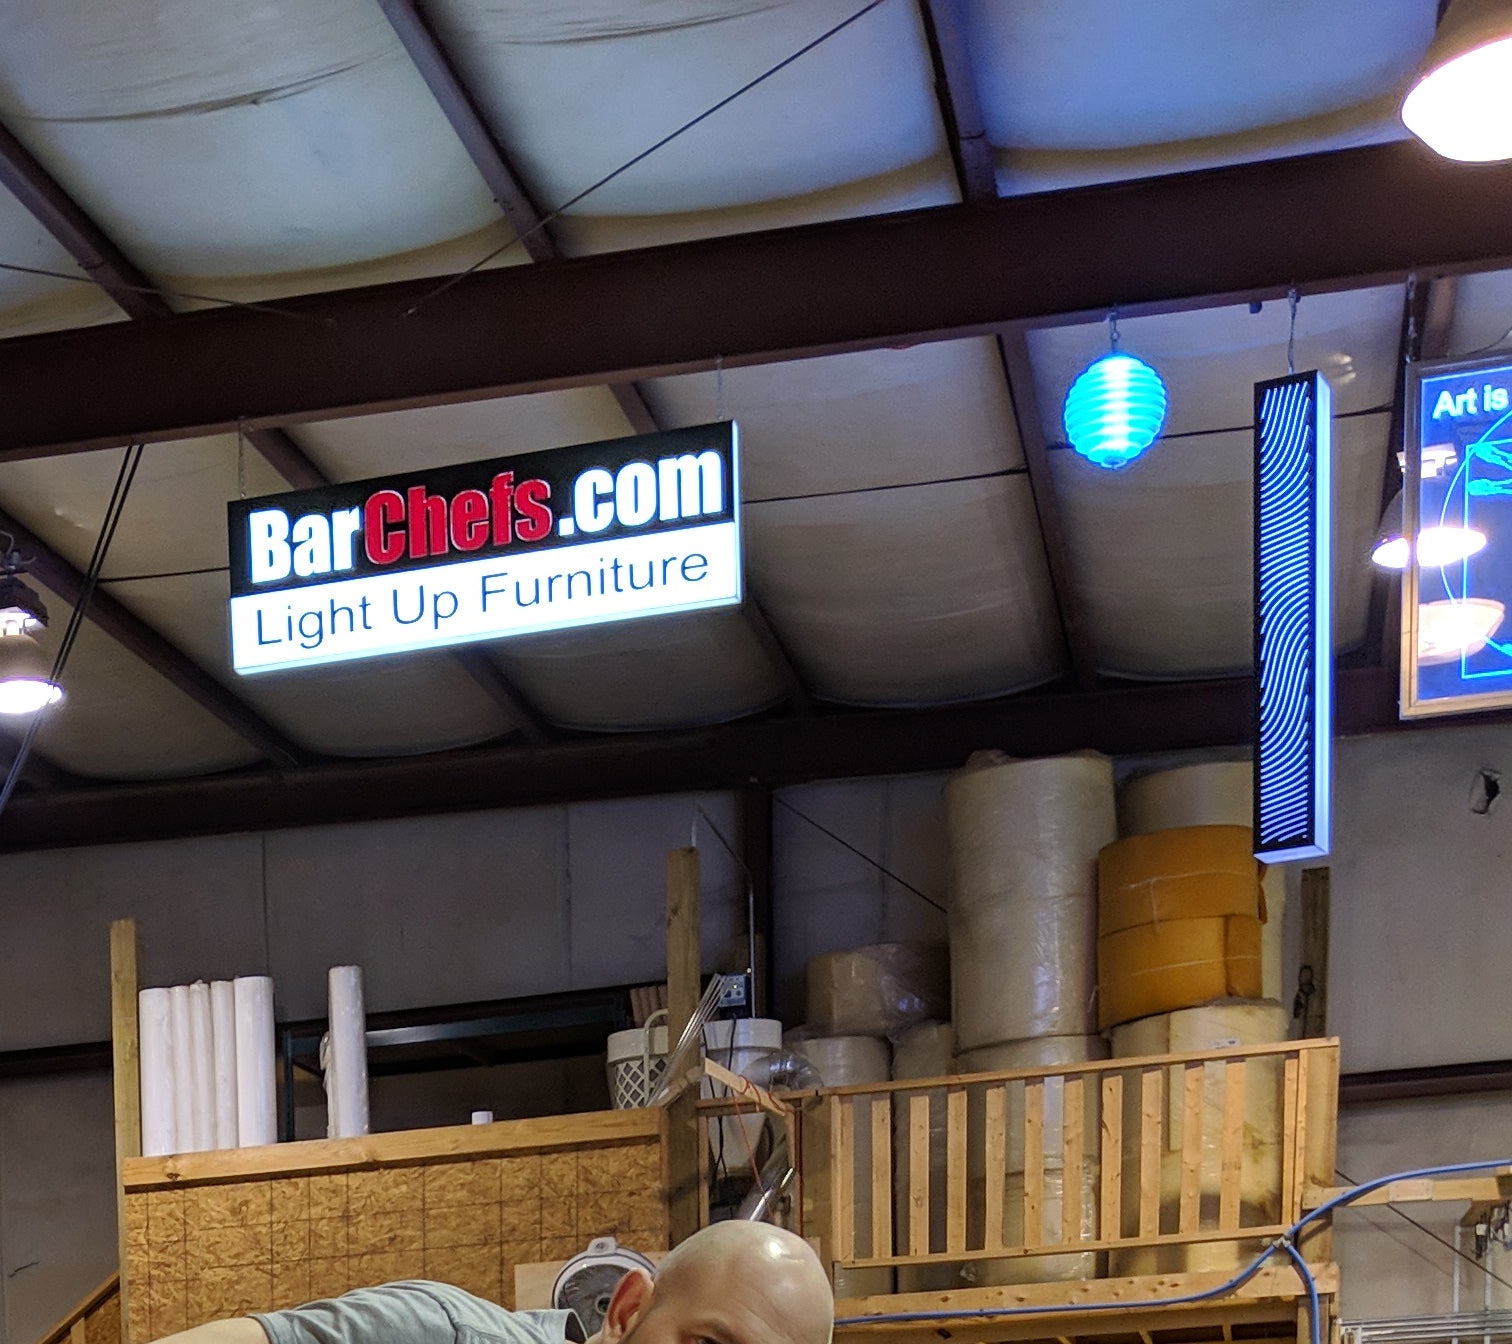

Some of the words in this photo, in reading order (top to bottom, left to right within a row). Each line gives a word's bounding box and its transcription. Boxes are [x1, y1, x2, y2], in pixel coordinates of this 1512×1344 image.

[1432, 386, 1478, 420] Art
[1483, 384, 1509, 412] is
[248, 448, 724, 584] BarChefs.com
[256, 595, 372, 649] Light
[392, 585, 460, 629] Up
[480, 552, 709, 613] Furniture
